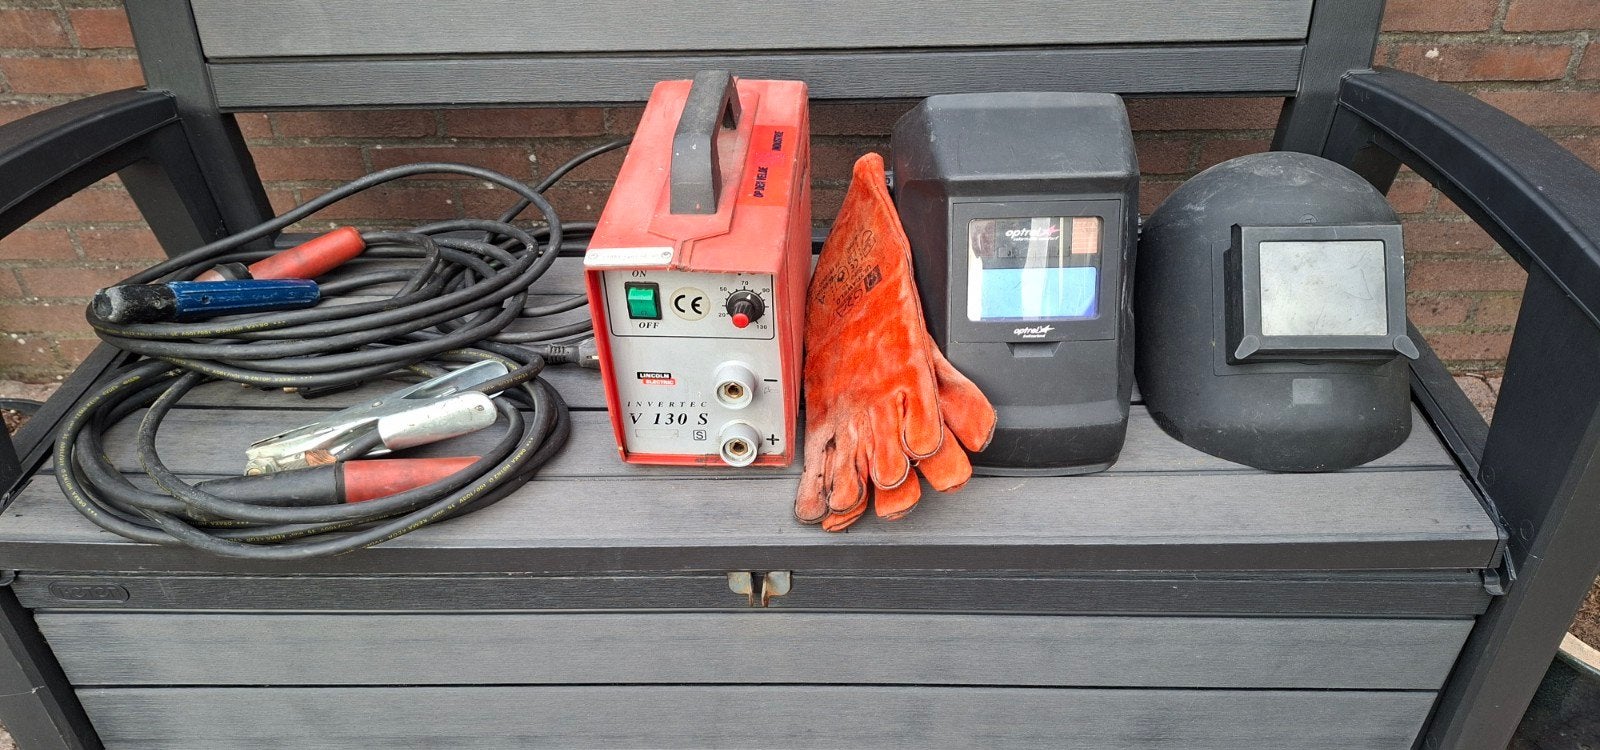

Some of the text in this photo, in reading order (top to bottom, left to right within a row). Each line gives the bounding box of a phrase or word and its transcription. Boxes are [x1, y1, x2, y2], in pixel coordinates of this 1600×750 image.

[674, 294, 702, 314] CE
[628, 412, 708, 426] V 130 S
[511, 448, 526, 464] DRAKA
